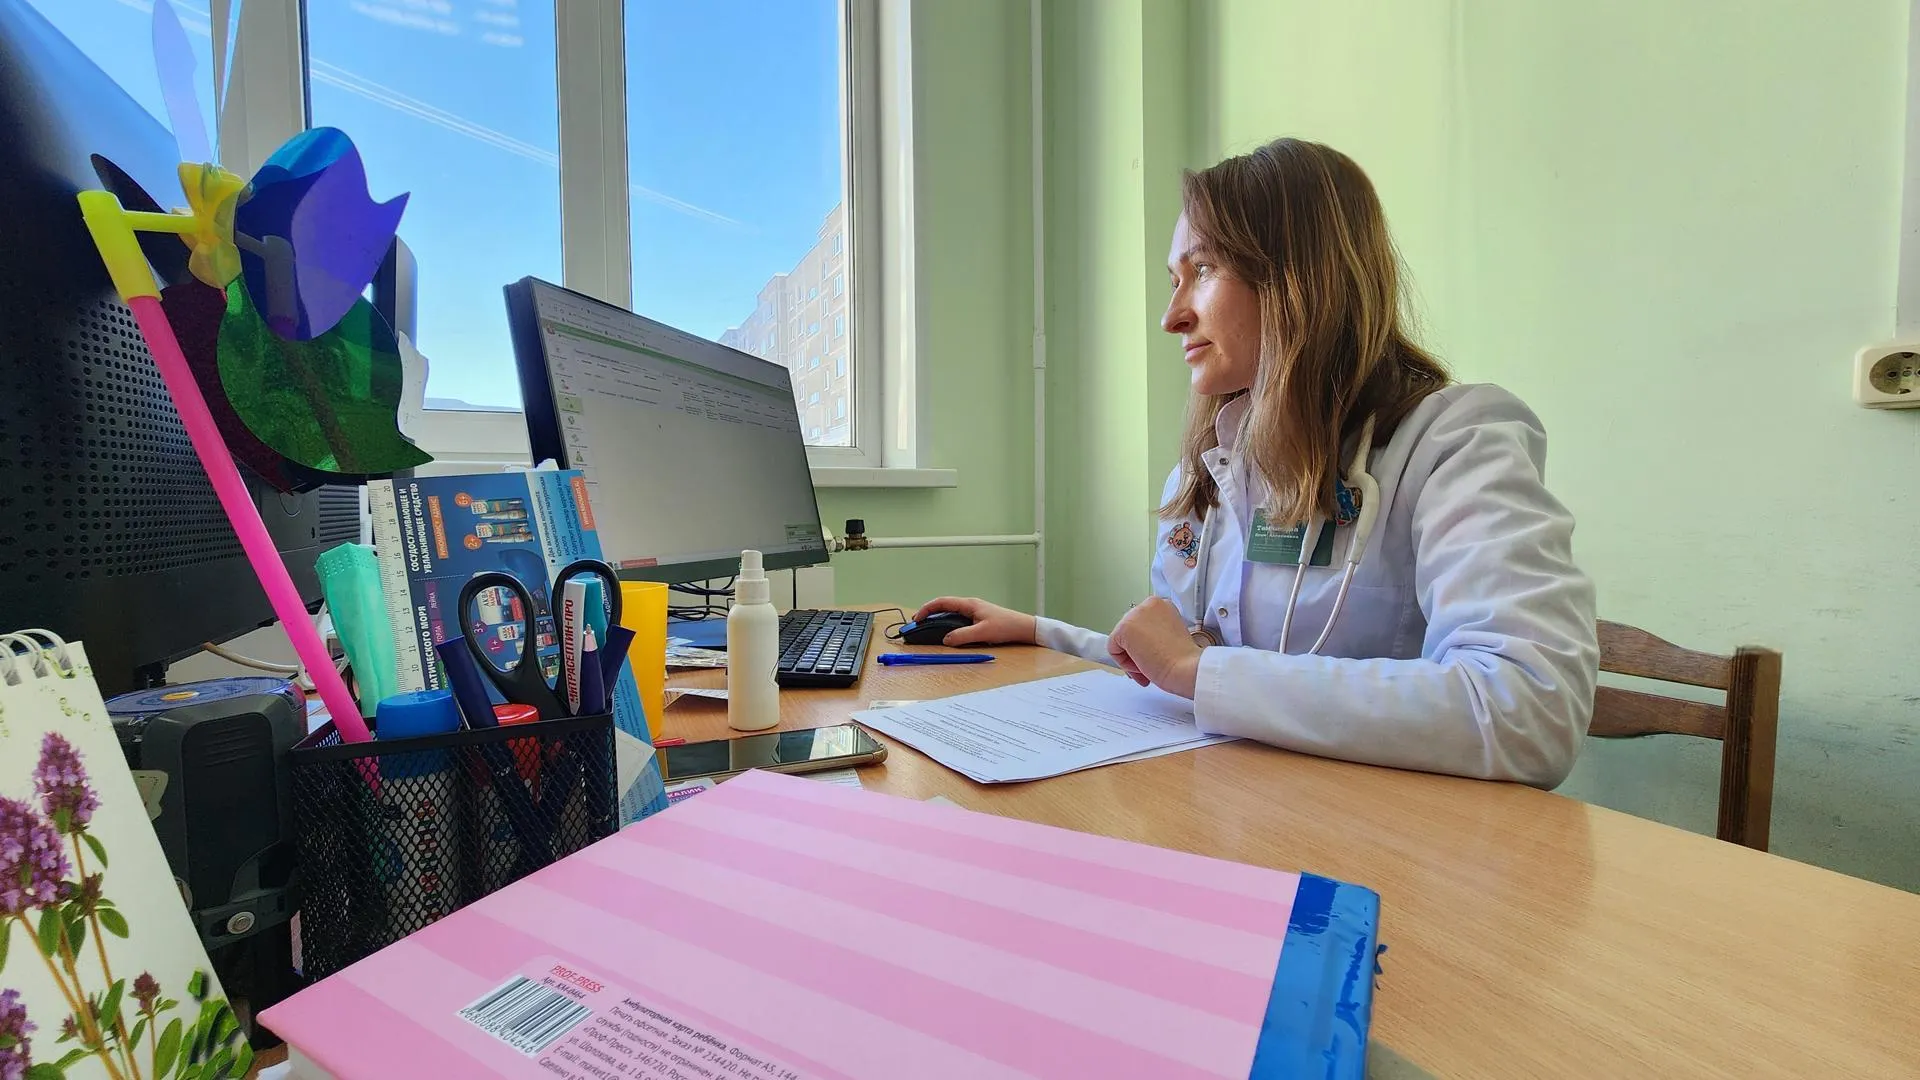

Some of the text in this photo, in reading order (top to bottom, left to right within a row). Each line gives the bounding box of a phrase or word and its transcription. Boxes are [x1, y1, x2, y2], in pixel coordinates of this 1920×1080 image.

[400, 494, 420, 572] СОСУДОСУЖИВАЮЩЕЕ
[410, 483, 433, 574] УВЛАЖНЯЮЩЕЕ СРЕДСТВО
[467, 538, 478, 547] 2+
[393, 552, 402, 560] 16
[418, 605, 429, 629] МОРЯ
[473, 622, 484, 633] 3+
[408, 644, 416, 652] 11
[490, 640, 501, 650] 1+
[411, 664, 419, 672] 10
[550, 965, 605, 993] PROF-PRESS
[609, 1006, 634, 1022] Печать
[633, 1019, 670, 1039] офсетная.
[668, 1034, 692, 1050] Заказ
[690, 1045, 705, 1055] №
[737, 1067, 752, 1080] Не
[622, 998, 673, 1025] Амбулаторная
[671, 1021, 695, 1036] карта
[691, 1031, 728, 1052] ребёнка.
[729, 1047, 764, 1067] Формат
[553, 1045, 580, 1063] E-mail:
[596, 1017, 715, 1079] службы (годности) не ограничен.
[538, 1056, 570, 1079] Сделано
